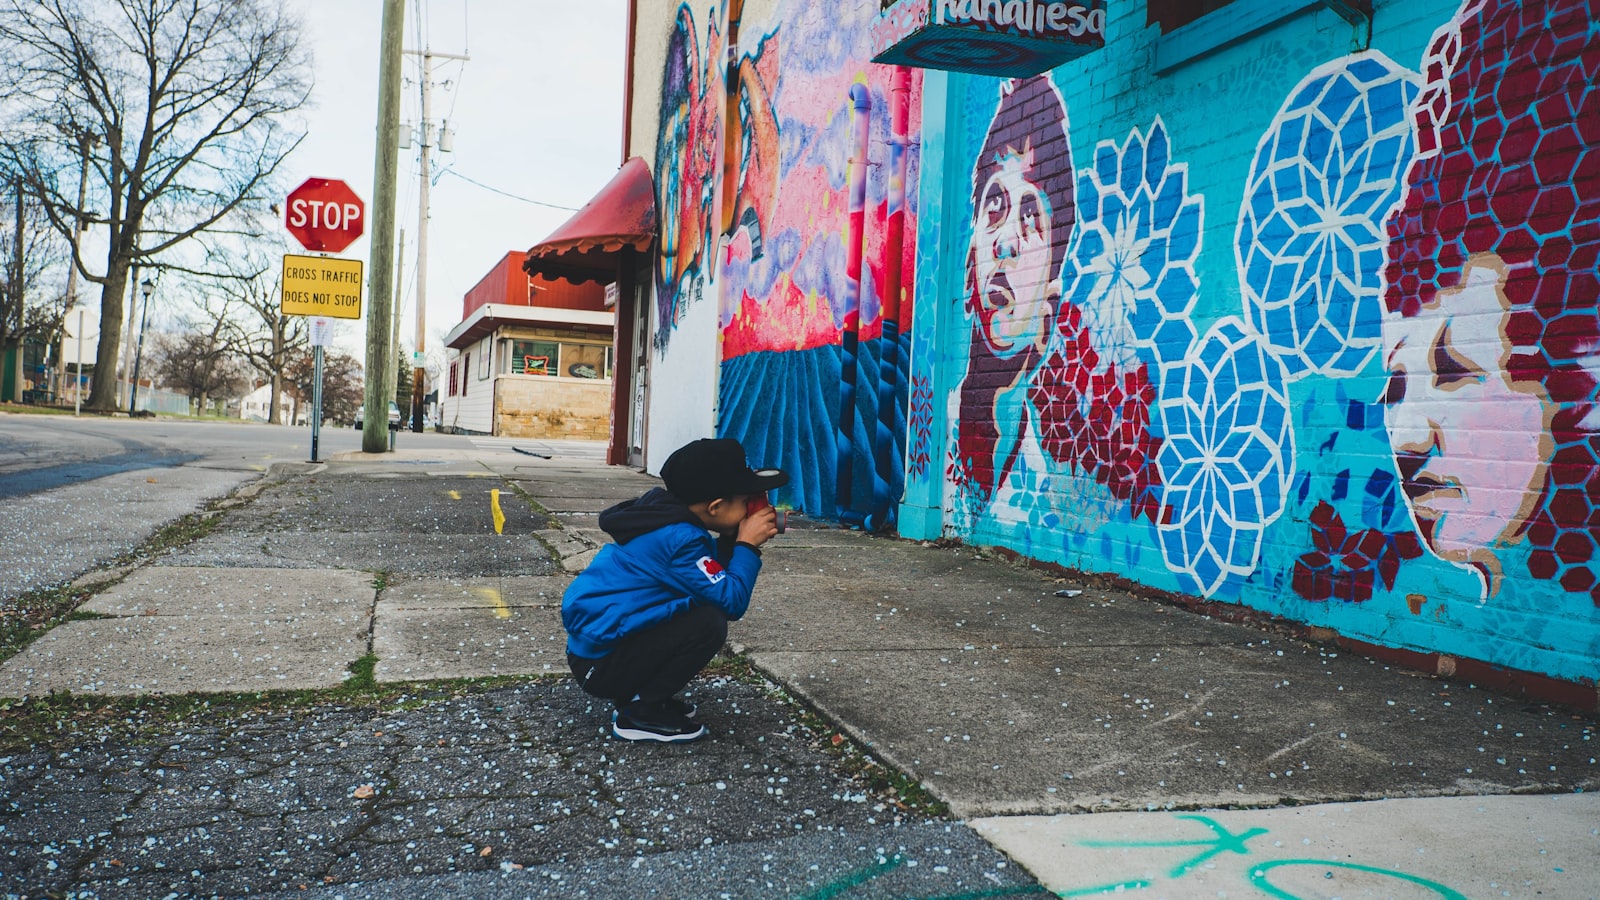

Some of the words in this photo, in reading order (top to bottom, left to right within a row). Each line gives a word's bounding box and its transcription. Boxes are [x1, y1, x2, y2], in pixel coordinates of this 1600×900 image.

[290, 199, 360, 230] STOP
[286, 267, 317, 281] CROSS
[321, 270, 359, 284] TRAFFIC
[284, 291, 309, 304] DOES
[312, 292, 331, 305] NOT
[334, 294, 358, 307] STOP
